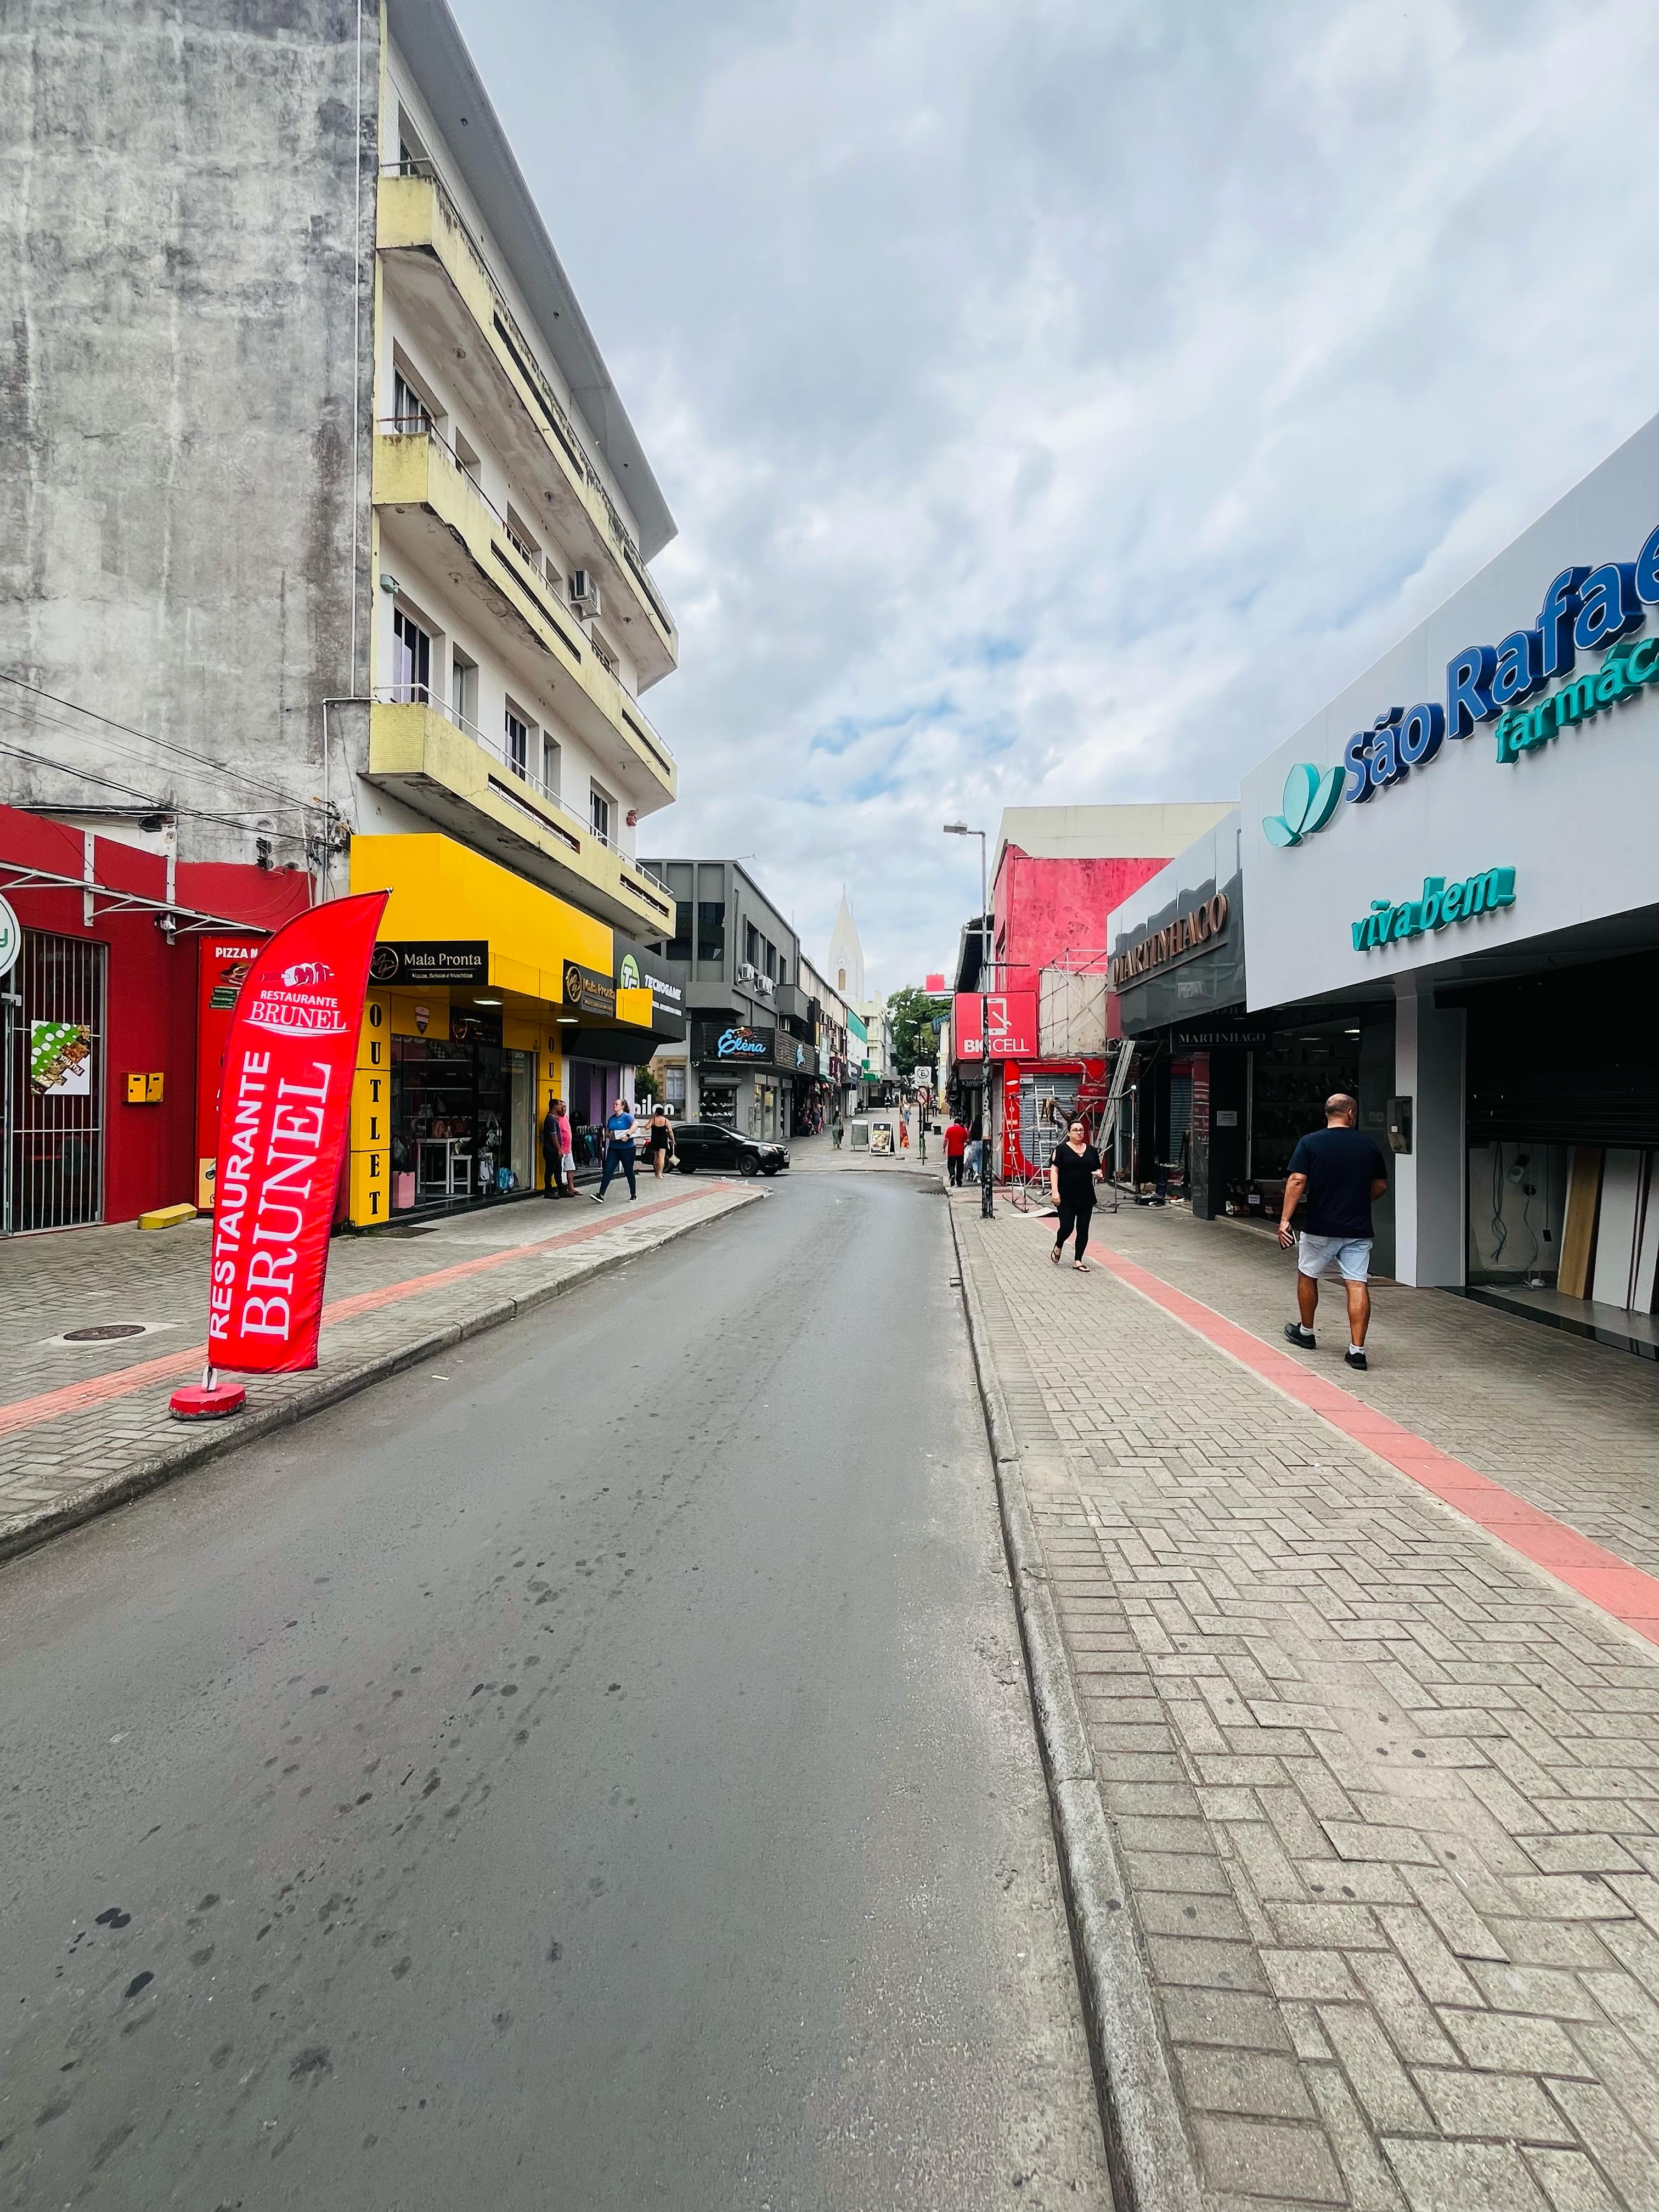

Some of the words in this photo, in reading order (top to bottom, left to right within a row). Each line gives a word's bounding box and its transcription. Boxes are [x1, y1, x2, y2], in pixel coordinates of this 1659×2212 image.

[1344, 707, 1444, 804] São
[215, 947, 249, 958] PIZZA
[1113, 893, 1228, 986] MARTINHAGO
[404, 953, 436, 966] Mala
[438, 953, 482, 966] Pronta
[260, 990, 338, 1008] RESTAURANTE
[645, 973, 682, 1001] TECNOGAME
[249, 1001, 347, 1030] BRUNEL
[718, 1029, 766, 1058] Elena
[1179, 1032, 1266, 1043] MARTINHAGO
[369, 1003, 383, 1215] OUTLET
[210, 1050, 270, 1340] RESTAURANTE
[240, 1061, 332, 1341] BRUNEL
